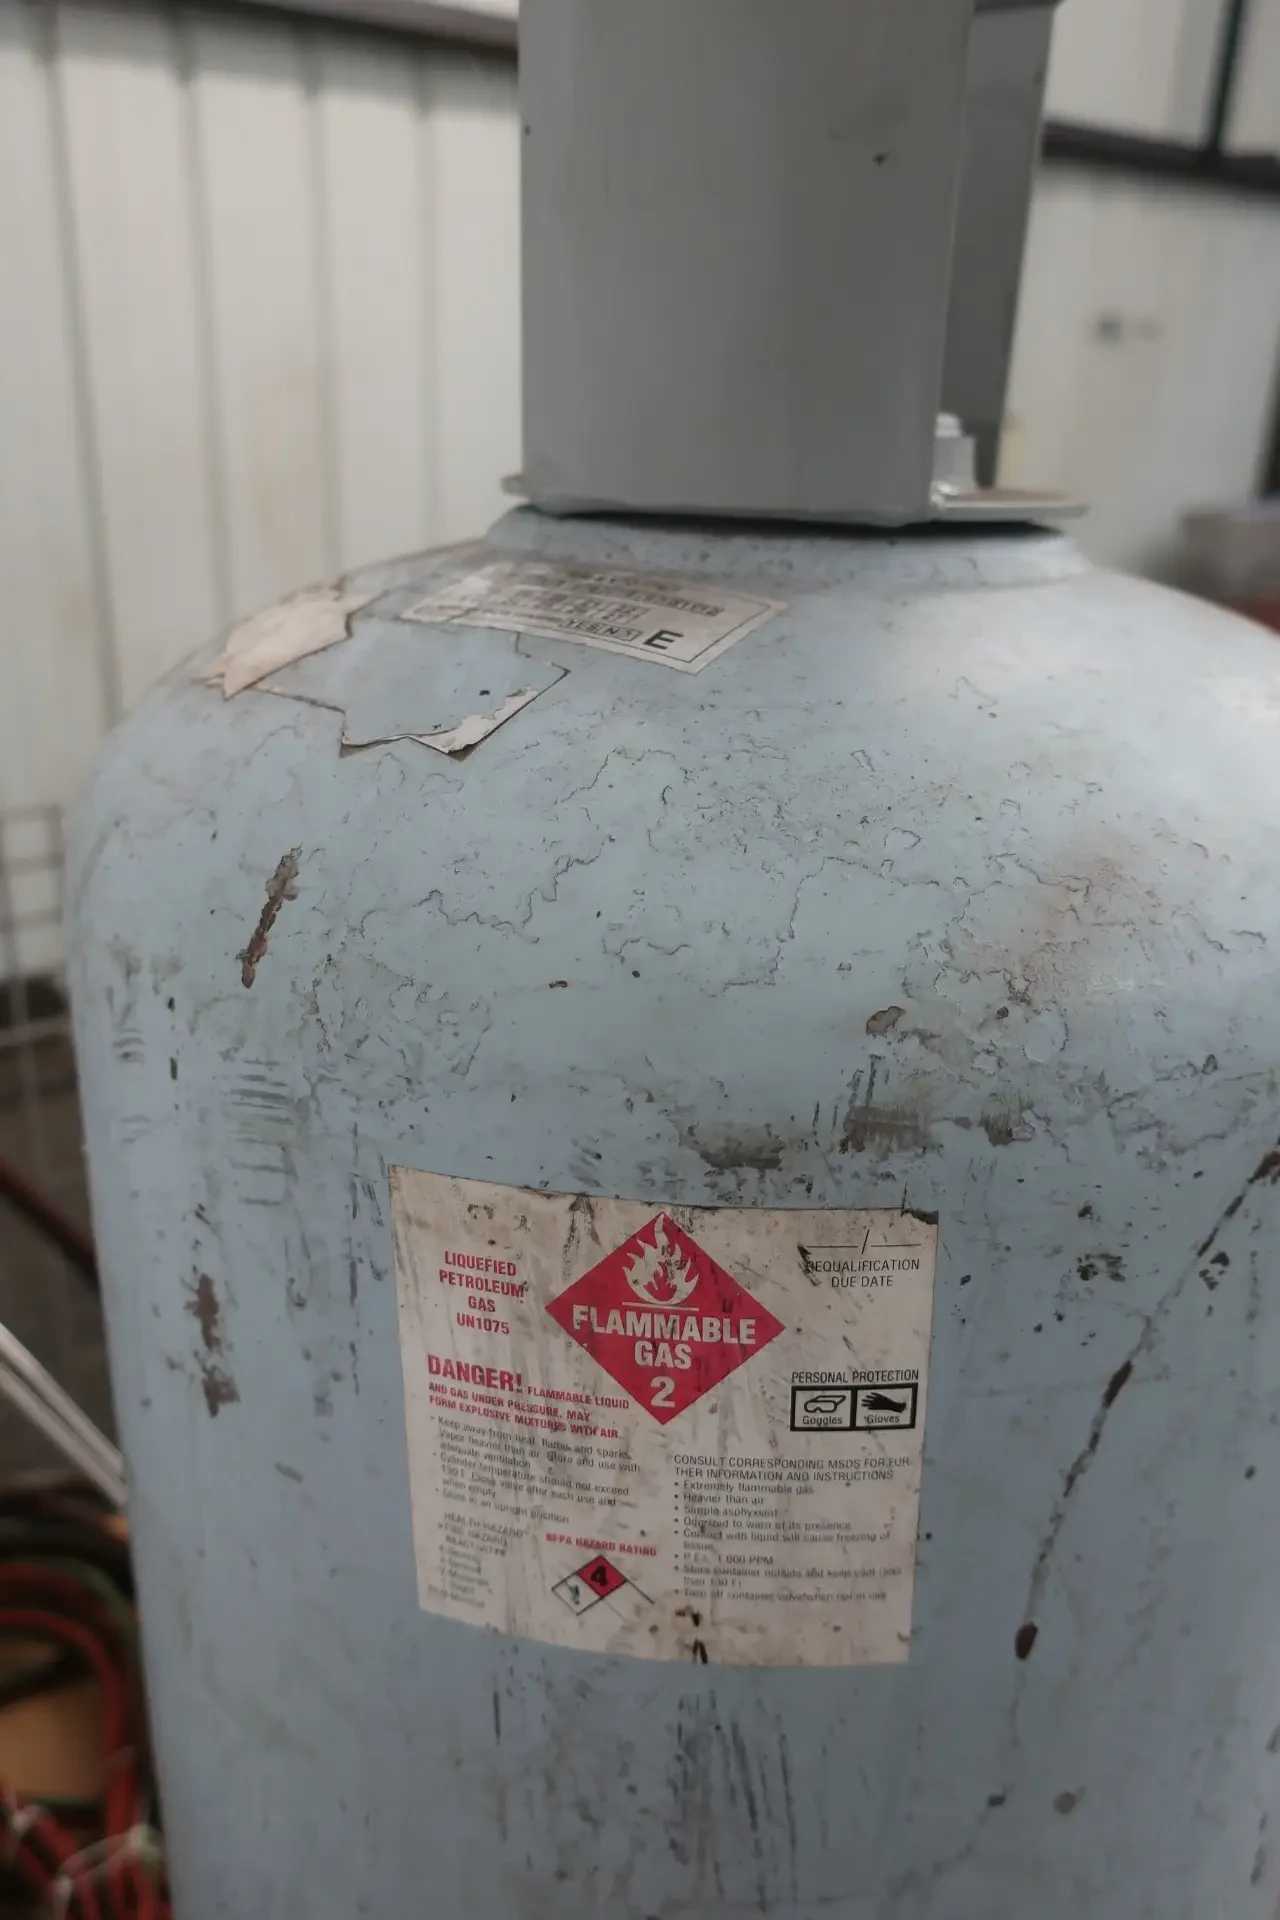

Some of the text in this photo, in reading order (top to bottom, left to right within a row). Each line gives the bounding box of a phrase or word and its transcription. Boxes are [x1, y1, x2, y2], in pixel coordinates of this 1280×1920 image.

[644, 629, 684, 650] E
[445, 1250, 516, 1276] LIQUEFIED
[439, 1270, 526, 1298] PETROLEUM
[831, 1275, 894, 1288] DUE DATE
[468, 1296, 496, 1312] GAS
[456, 1312, 509, 1335] UN1075
[573, 1305, 756, 1345] FLAMMABLE
[634, 1341, 692, 1370] GAS
[428, 1354, 630, 1409] DANGER! FLAMMABLE LIQUID
[791, 1369, 919, 1383] PERSONAL PROTECTION
[429, 1382, 448, 1395] AND
[450, 1386, 469, 1399] GAS
[471, 1390, 505, 1407] UNDER
[566, 1409, 591, 1422] MAY
[650, 1376, 675, 1408] 2
[429, 1395, 456, 1409] FORM
[459, 1402, 512, 1423] EXPLOSIVE
[570, 1423, 599, 1437] WITH
[802, 1415, 842, 1426] Goggles
[866, 1414, 900, 1424] Gloves
[674, 1455, 725, 1466] CONSULT
[729, 1457, 824, 1469] CORRESPONDING
[828, 1459, 861, 1470] MSDS
[864, 1458, 885, 1468] FOR
[675, 1467, 703, 1478] THER
[706, 1469, 783, 1480] INFORMATION
[786, 1471, 810, 1481] AND
[683, 1480, 735, 1493] Extremely
[590, 1565, 609, 1587] 4
